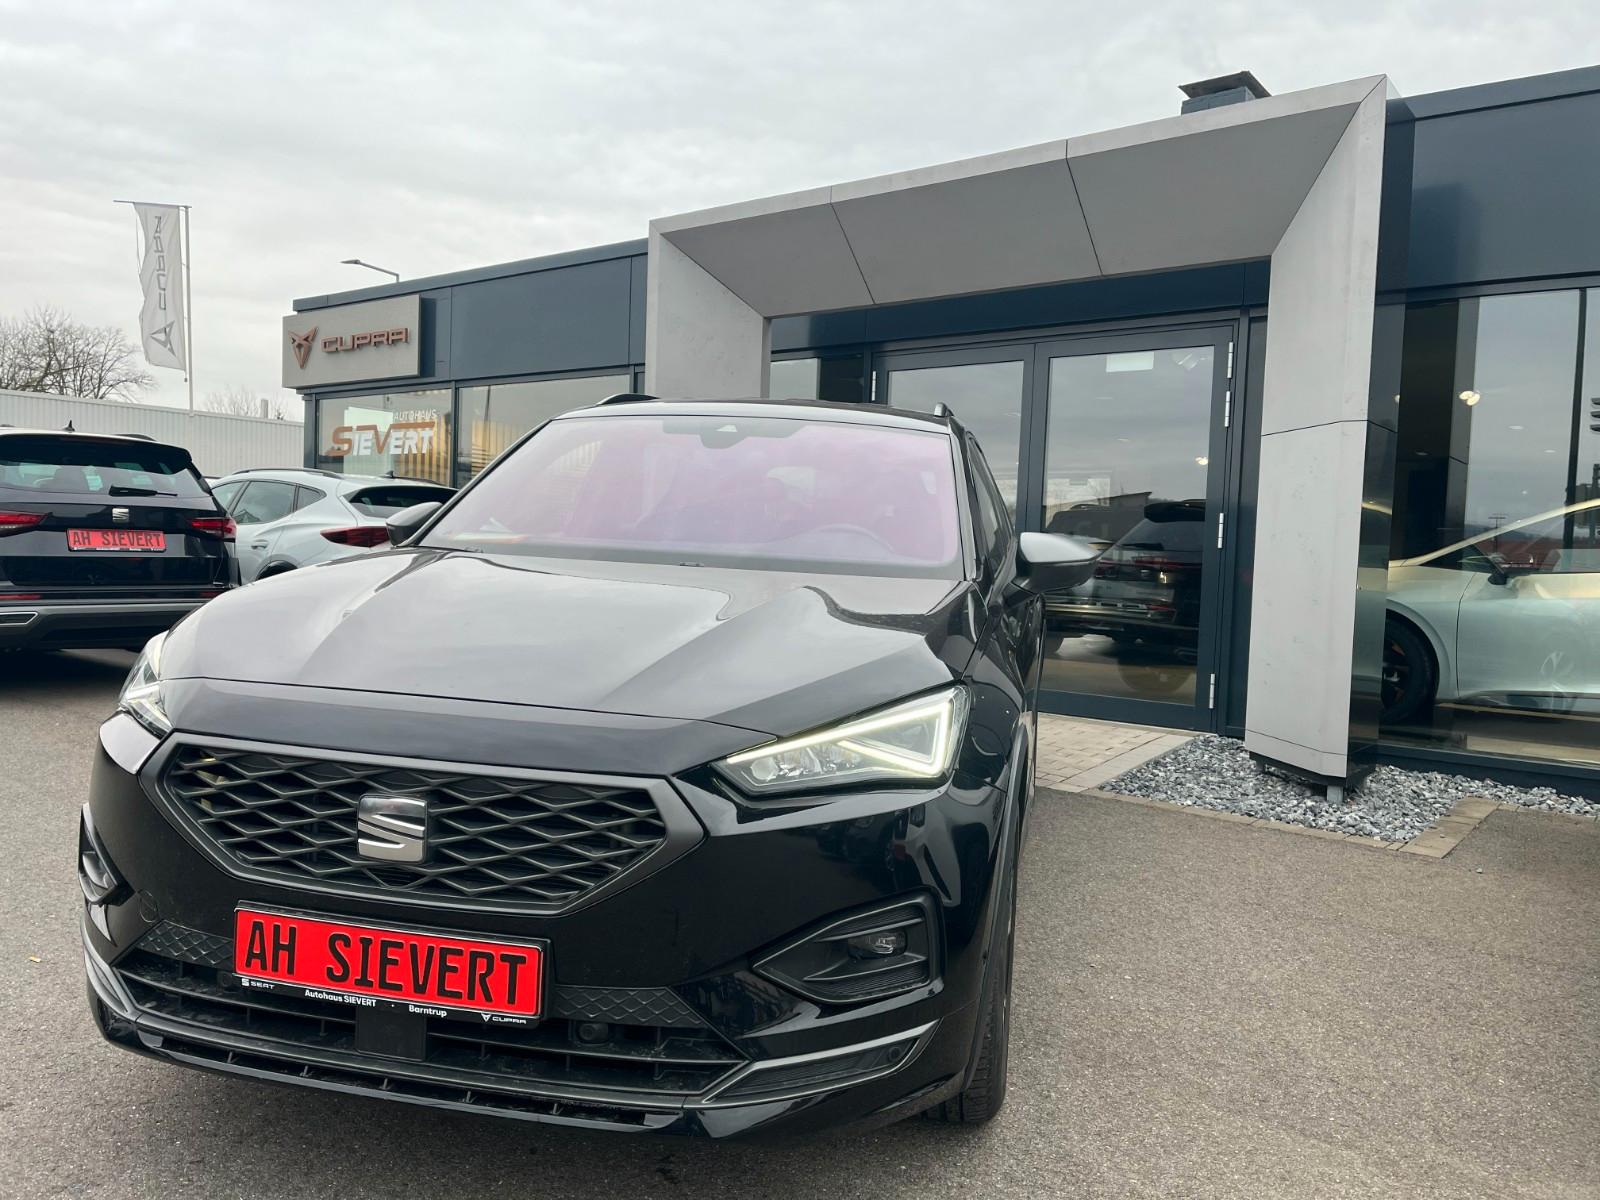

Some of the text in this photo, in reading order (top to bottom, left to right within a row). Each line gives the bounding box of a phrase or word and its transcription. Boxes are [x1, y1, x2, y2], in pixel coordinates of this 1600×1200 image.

[321, 327, 409, 353] CUPRA
[394, 408, 437, 420] AUTOHAUS
[73, 531, 161, 547] AH SIEVERT
[245, 919, 527, 1005] AH SIEVERT
[250, 980, 275, 990] SEAT
[304, 989, 448, 1018] Autohaus SIEVERT Barntrup
[492, 1016, 527, 1025] CUPRA
